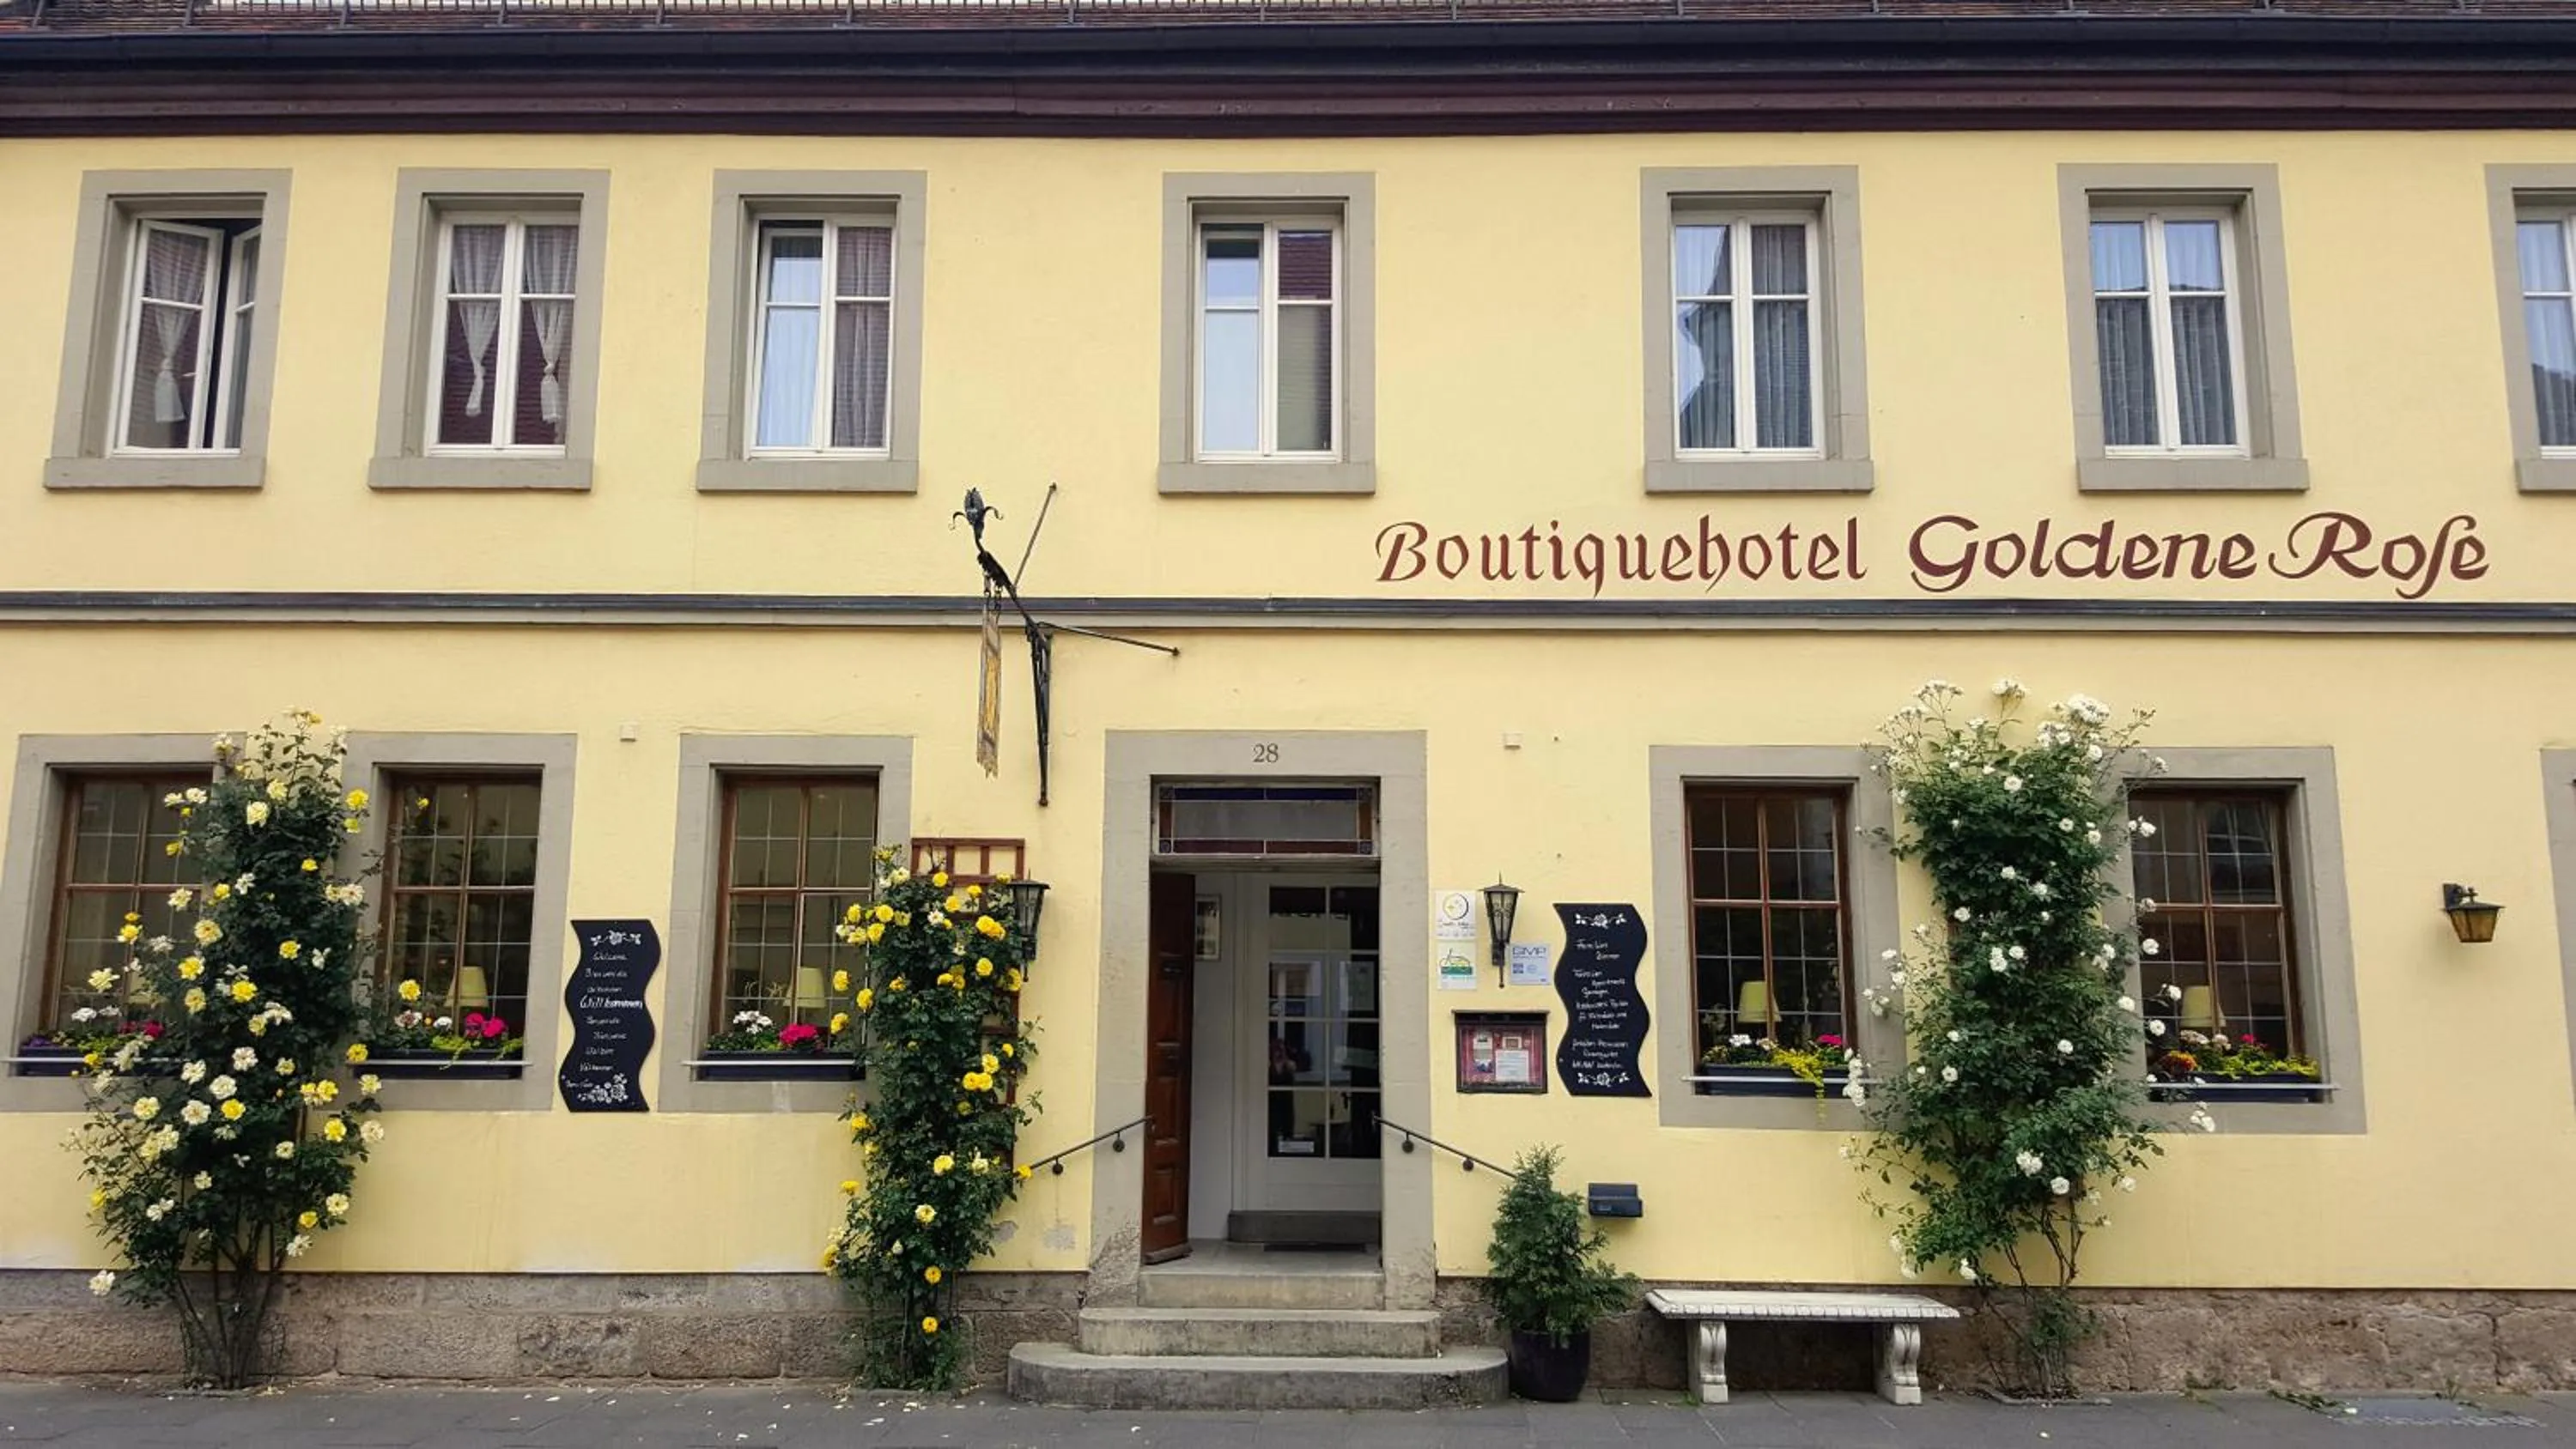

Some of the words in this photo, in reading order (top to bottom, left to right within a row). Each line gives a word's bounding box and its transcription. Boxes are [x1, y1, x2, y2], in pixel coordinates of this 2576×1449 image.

[1376, 514, 1868, 598] Boutiquehotel
[1908, 514, 2257, 592] Goldene
[1253, 743, 1279, 763] 28
